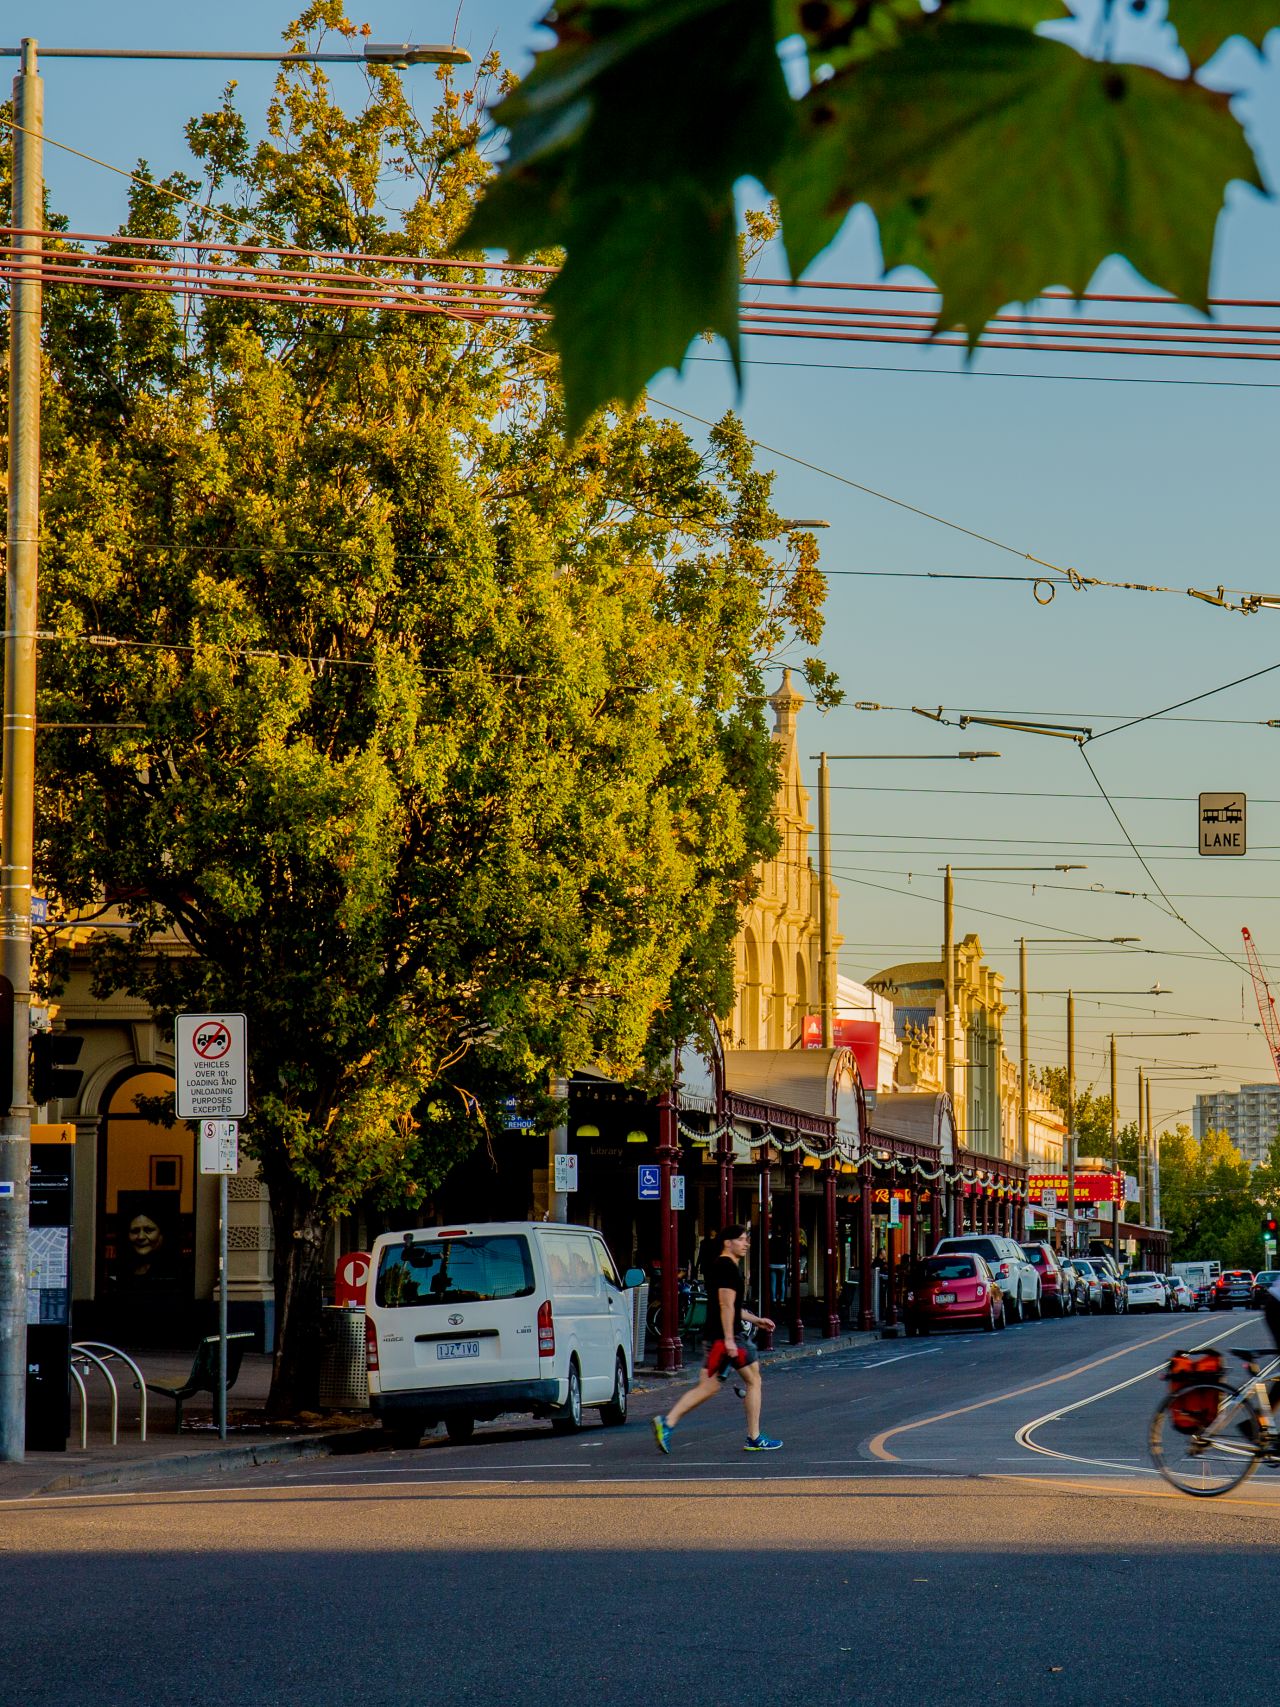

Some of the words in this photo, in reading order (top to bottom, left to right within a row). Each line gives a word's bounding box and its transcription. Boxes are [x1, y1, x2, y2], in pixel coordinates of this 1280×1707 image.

[1204, 833, 1241, 847] LANE
[193, 1061, 230, 1069] VEHICLES
[186, 1079, 218, 1087] LOADING
[221, 1078, 237, 1086] AND
[190, 1087, 233, 1096] UNLOADING
[191, 1096, 232, 1104] PURPOSES
[192, 1105, 232, 1114] EXCEPTED
[590, 1146, 623, 1157] Library
[1029, 1179, 1076, 1188] COMED
[1057, 1188, 1090, 1197] WEK
[439, 1344, 455, 1356] 1JZ
